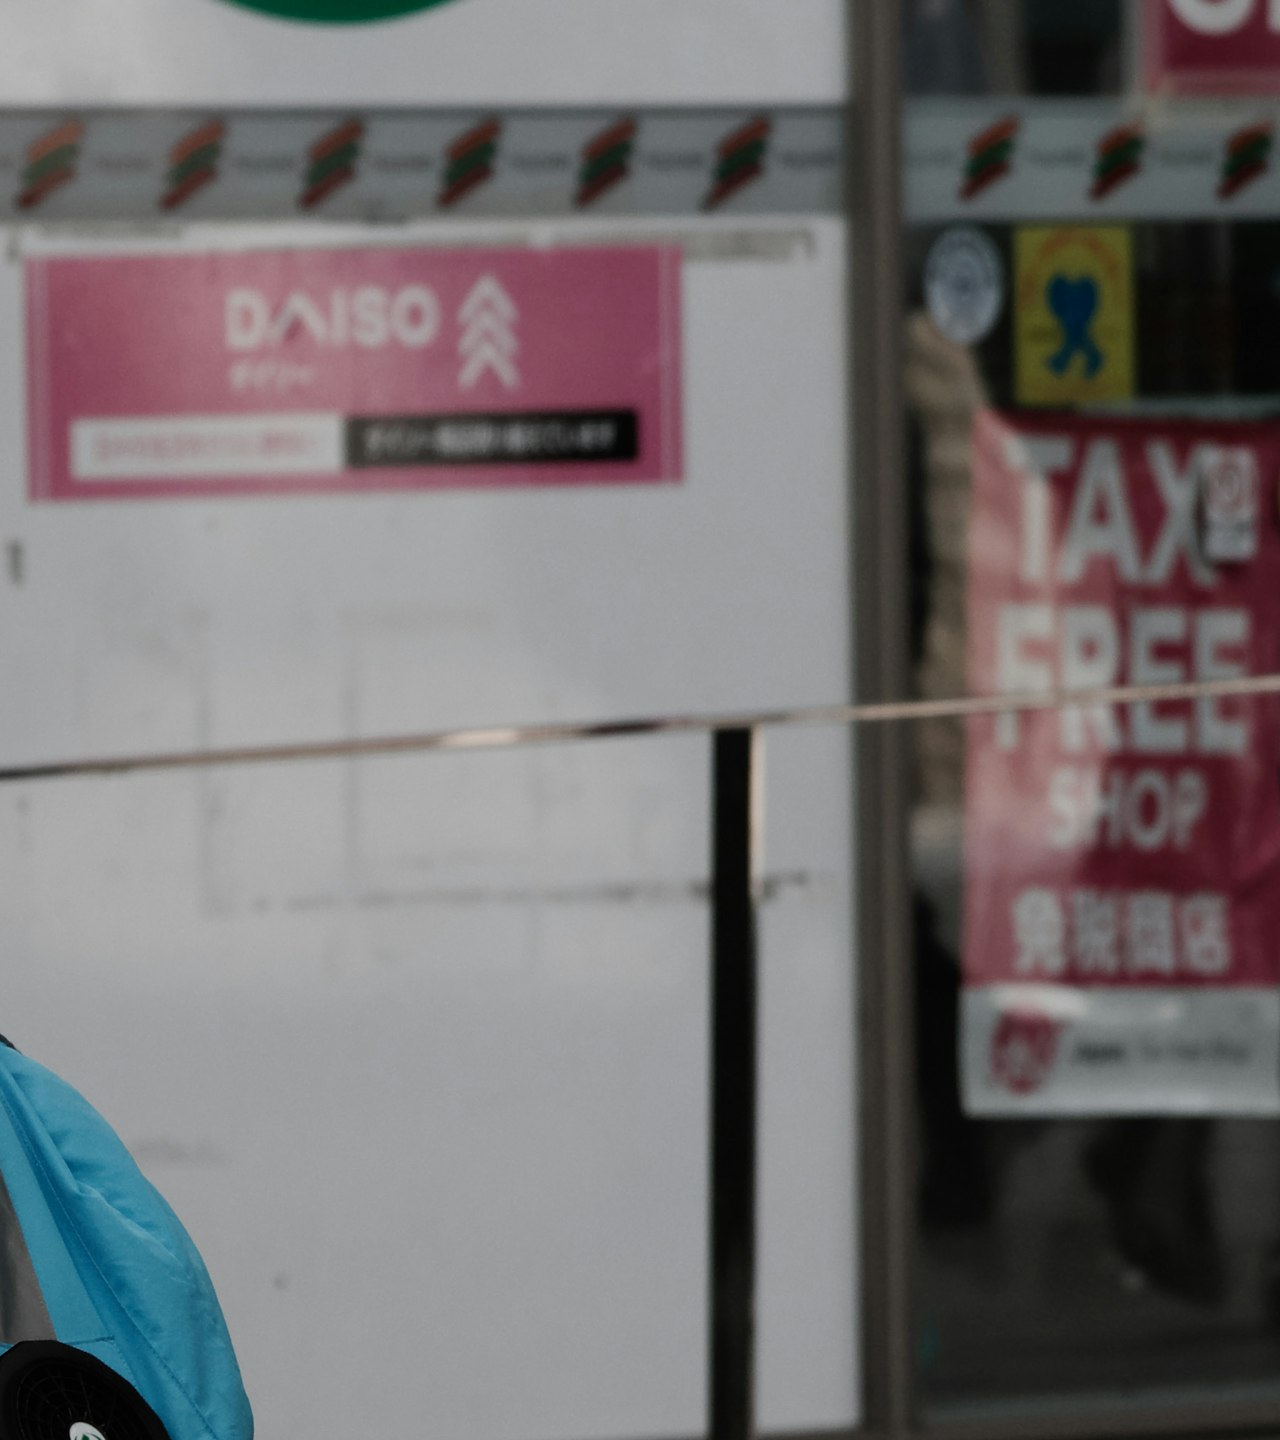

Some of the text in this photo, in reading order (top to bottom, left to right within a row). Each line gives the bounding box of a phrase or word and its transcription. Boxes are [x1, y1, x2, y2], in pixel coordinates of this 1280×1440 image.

[225, 285, 439, 348] DAISO
[1002, 436, 1222, 586] TAX
[996, 604, 1251, 753] FREE
[1046, 769, 1208, 854] SHOP
